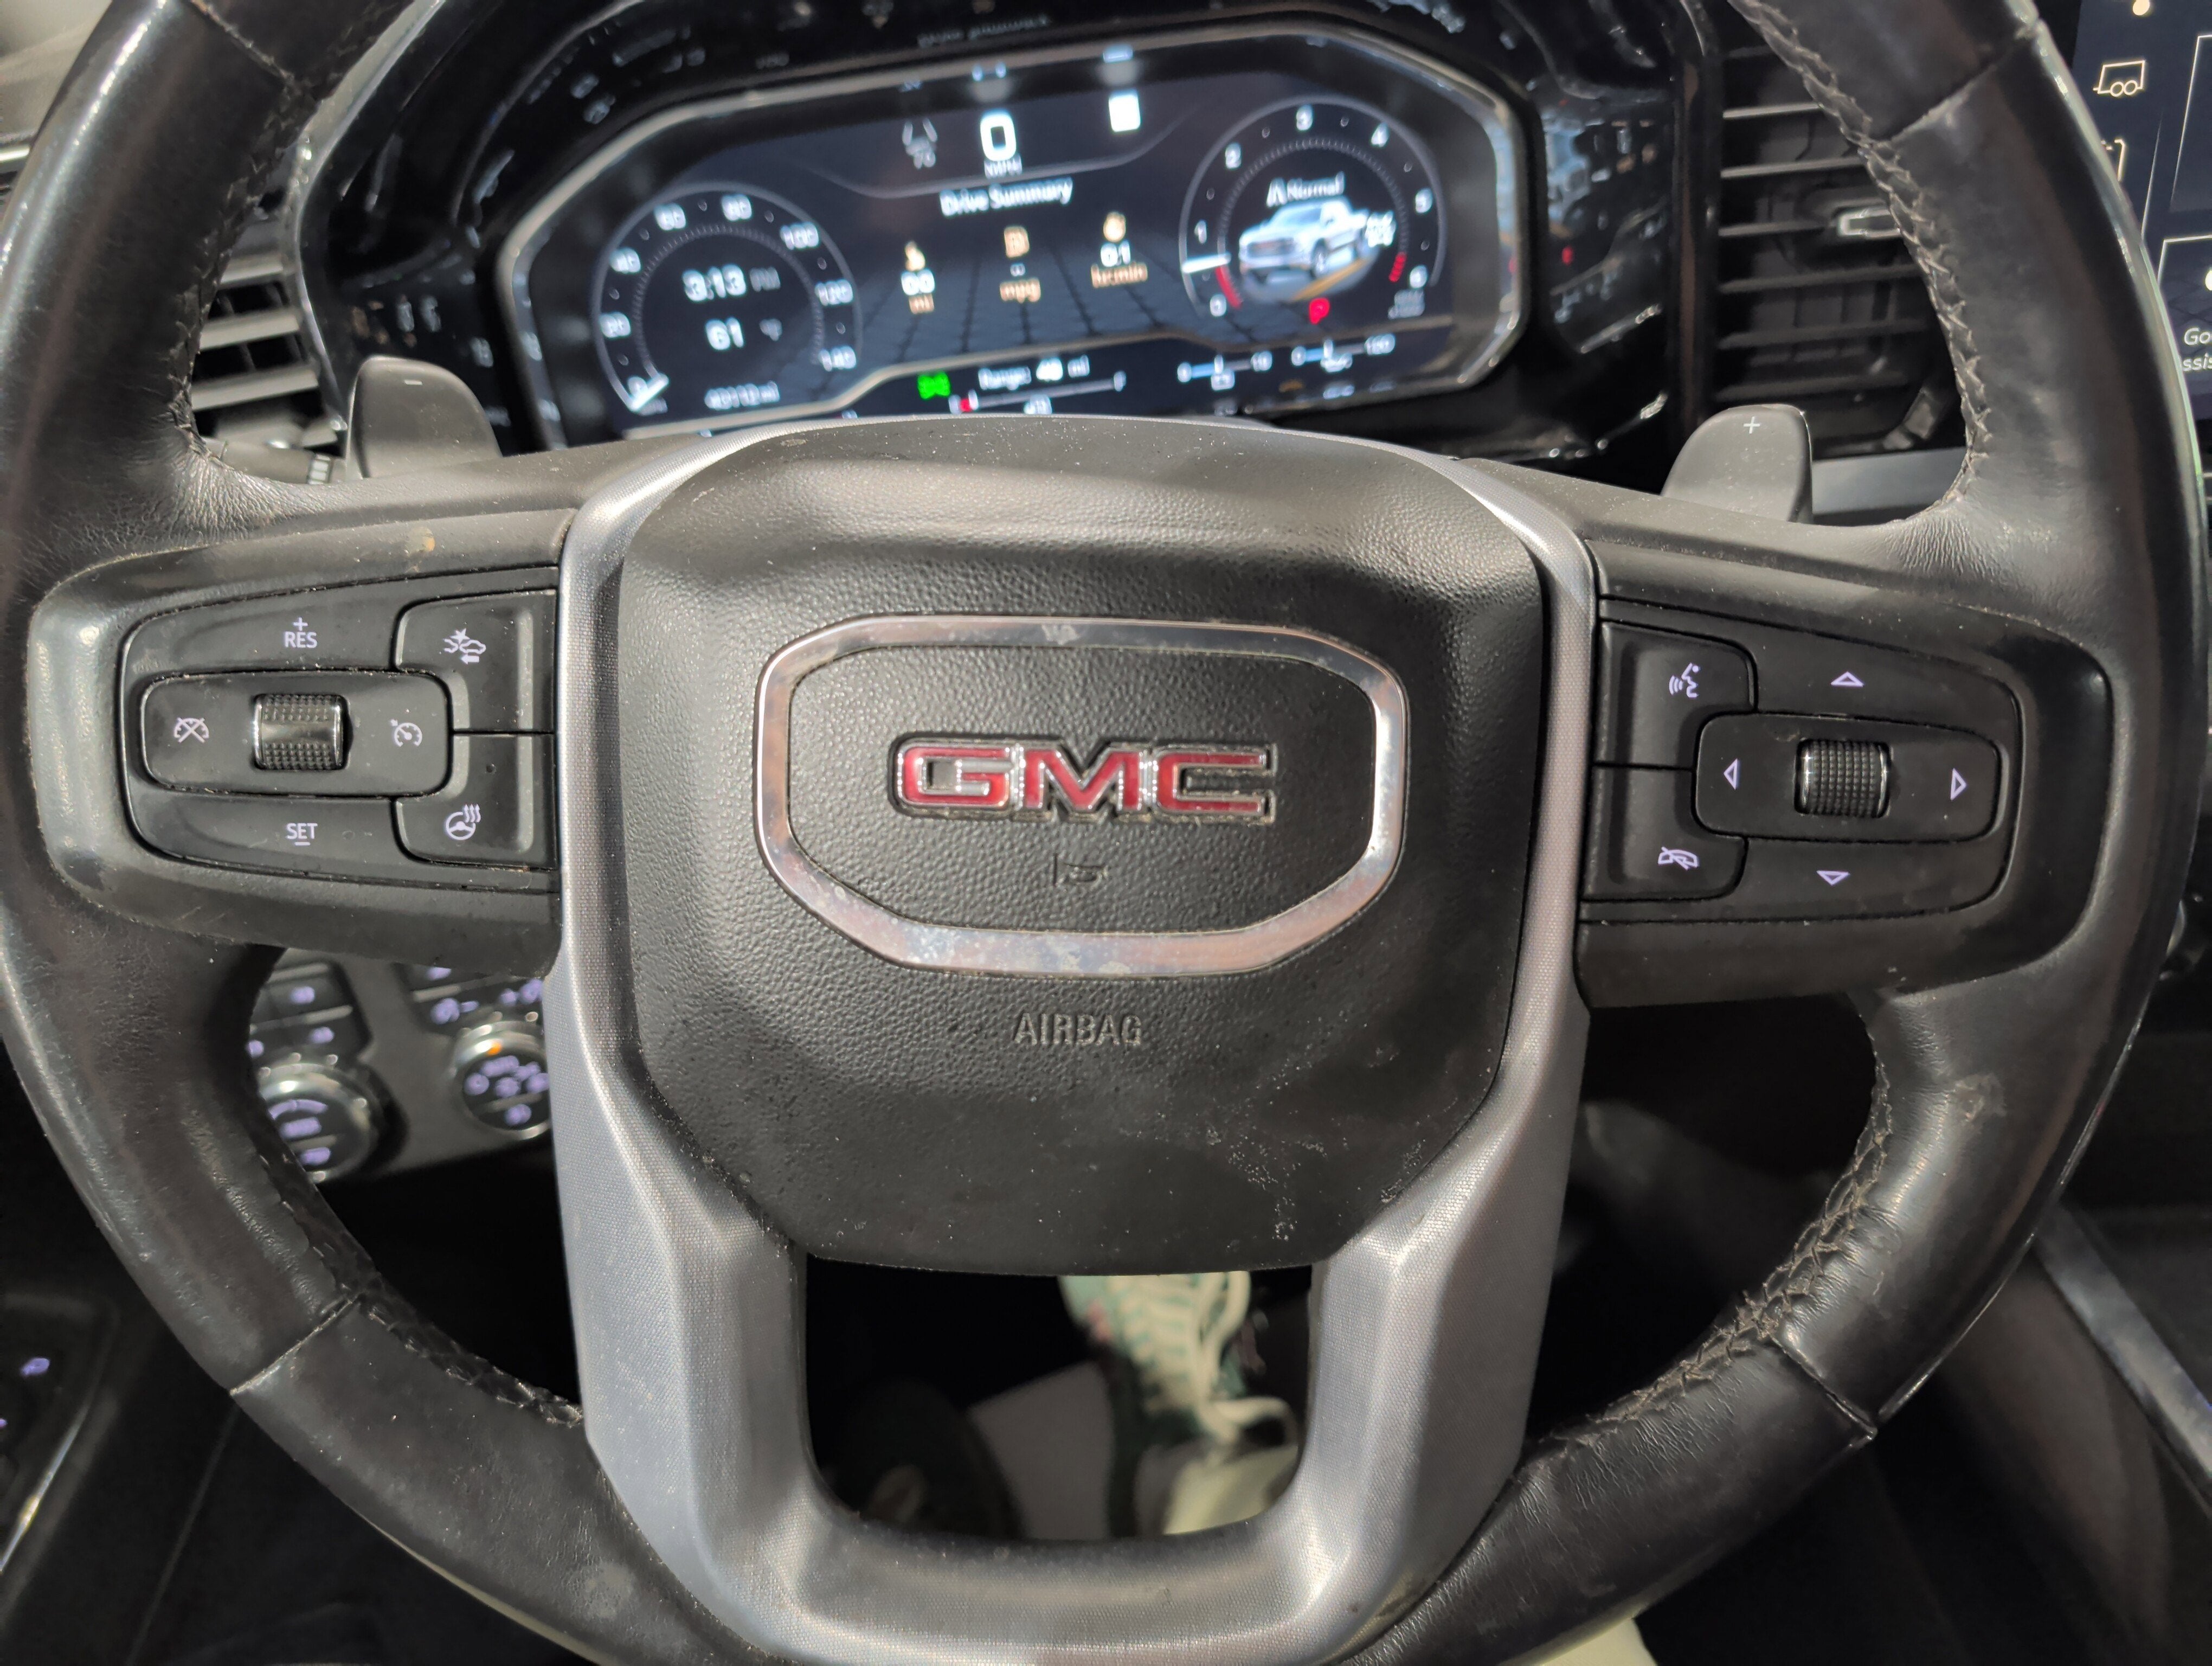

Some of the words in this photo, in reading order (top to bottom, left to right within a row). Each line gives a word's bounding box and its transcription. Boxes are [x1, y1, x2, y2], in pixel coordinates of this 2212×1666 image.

[980, 110, 1017, 162] 0
[940, 188, 989, 216] Drive
[988, 177, 1073, 208] Summary
[1287, 171, 1346, 202] Normal
[681, 264, 747, 302] 3:13
[705, 317, 744, 350] 61
[2184, 327, 2212, 345] Go
[284, 631, 318, 649] RES
[896, 738, 1275, 823] GMC
[286, 822, 318, 840] SET
[1013, 1012, 1143, 1047] AIRBAG
